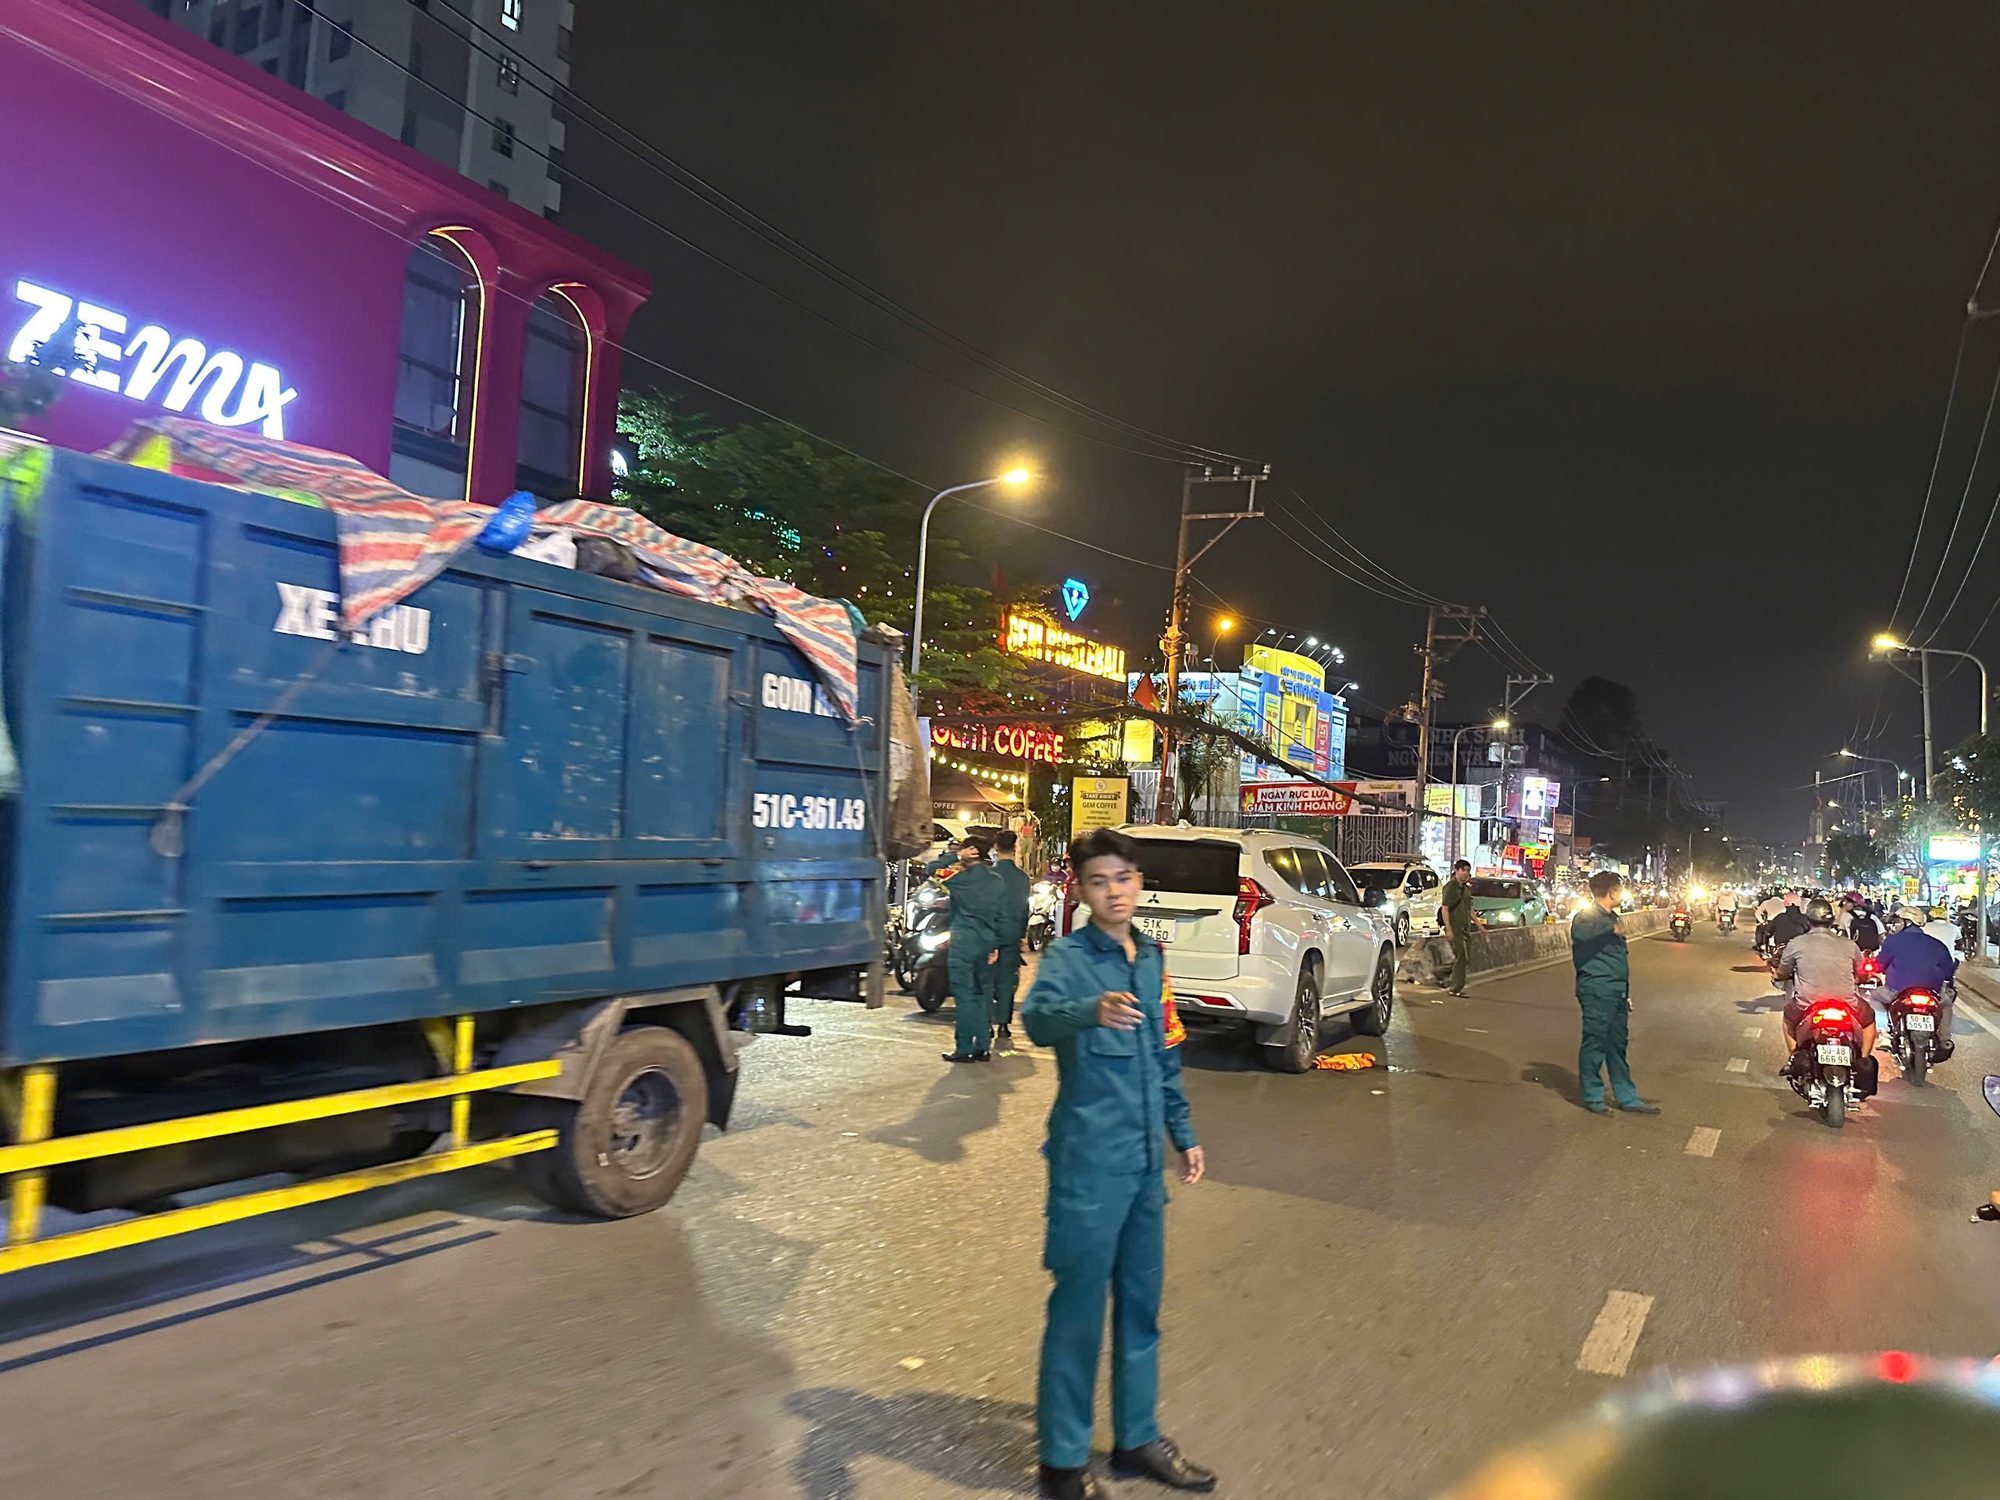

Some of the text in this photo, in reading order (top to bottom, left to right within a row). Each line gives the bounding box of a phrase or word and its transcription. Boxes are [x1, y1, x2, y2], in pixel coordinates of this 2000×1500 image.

[272, 582, 431, 655] XE HU
[762, 673, 812, 713] GOM
[994, 724, 1065, 764] COFFEE
[932, 802, 956, 810] OFFEE
[1261, 789, 1287, 800] NGÀY
[1276, 800, 1302, 812] KINH
[1304, 799, 1343, 811] HOÀNG
[753, 792, 866, 831] 51C-361.43
[1143, 918, 1162, 929] 51K
